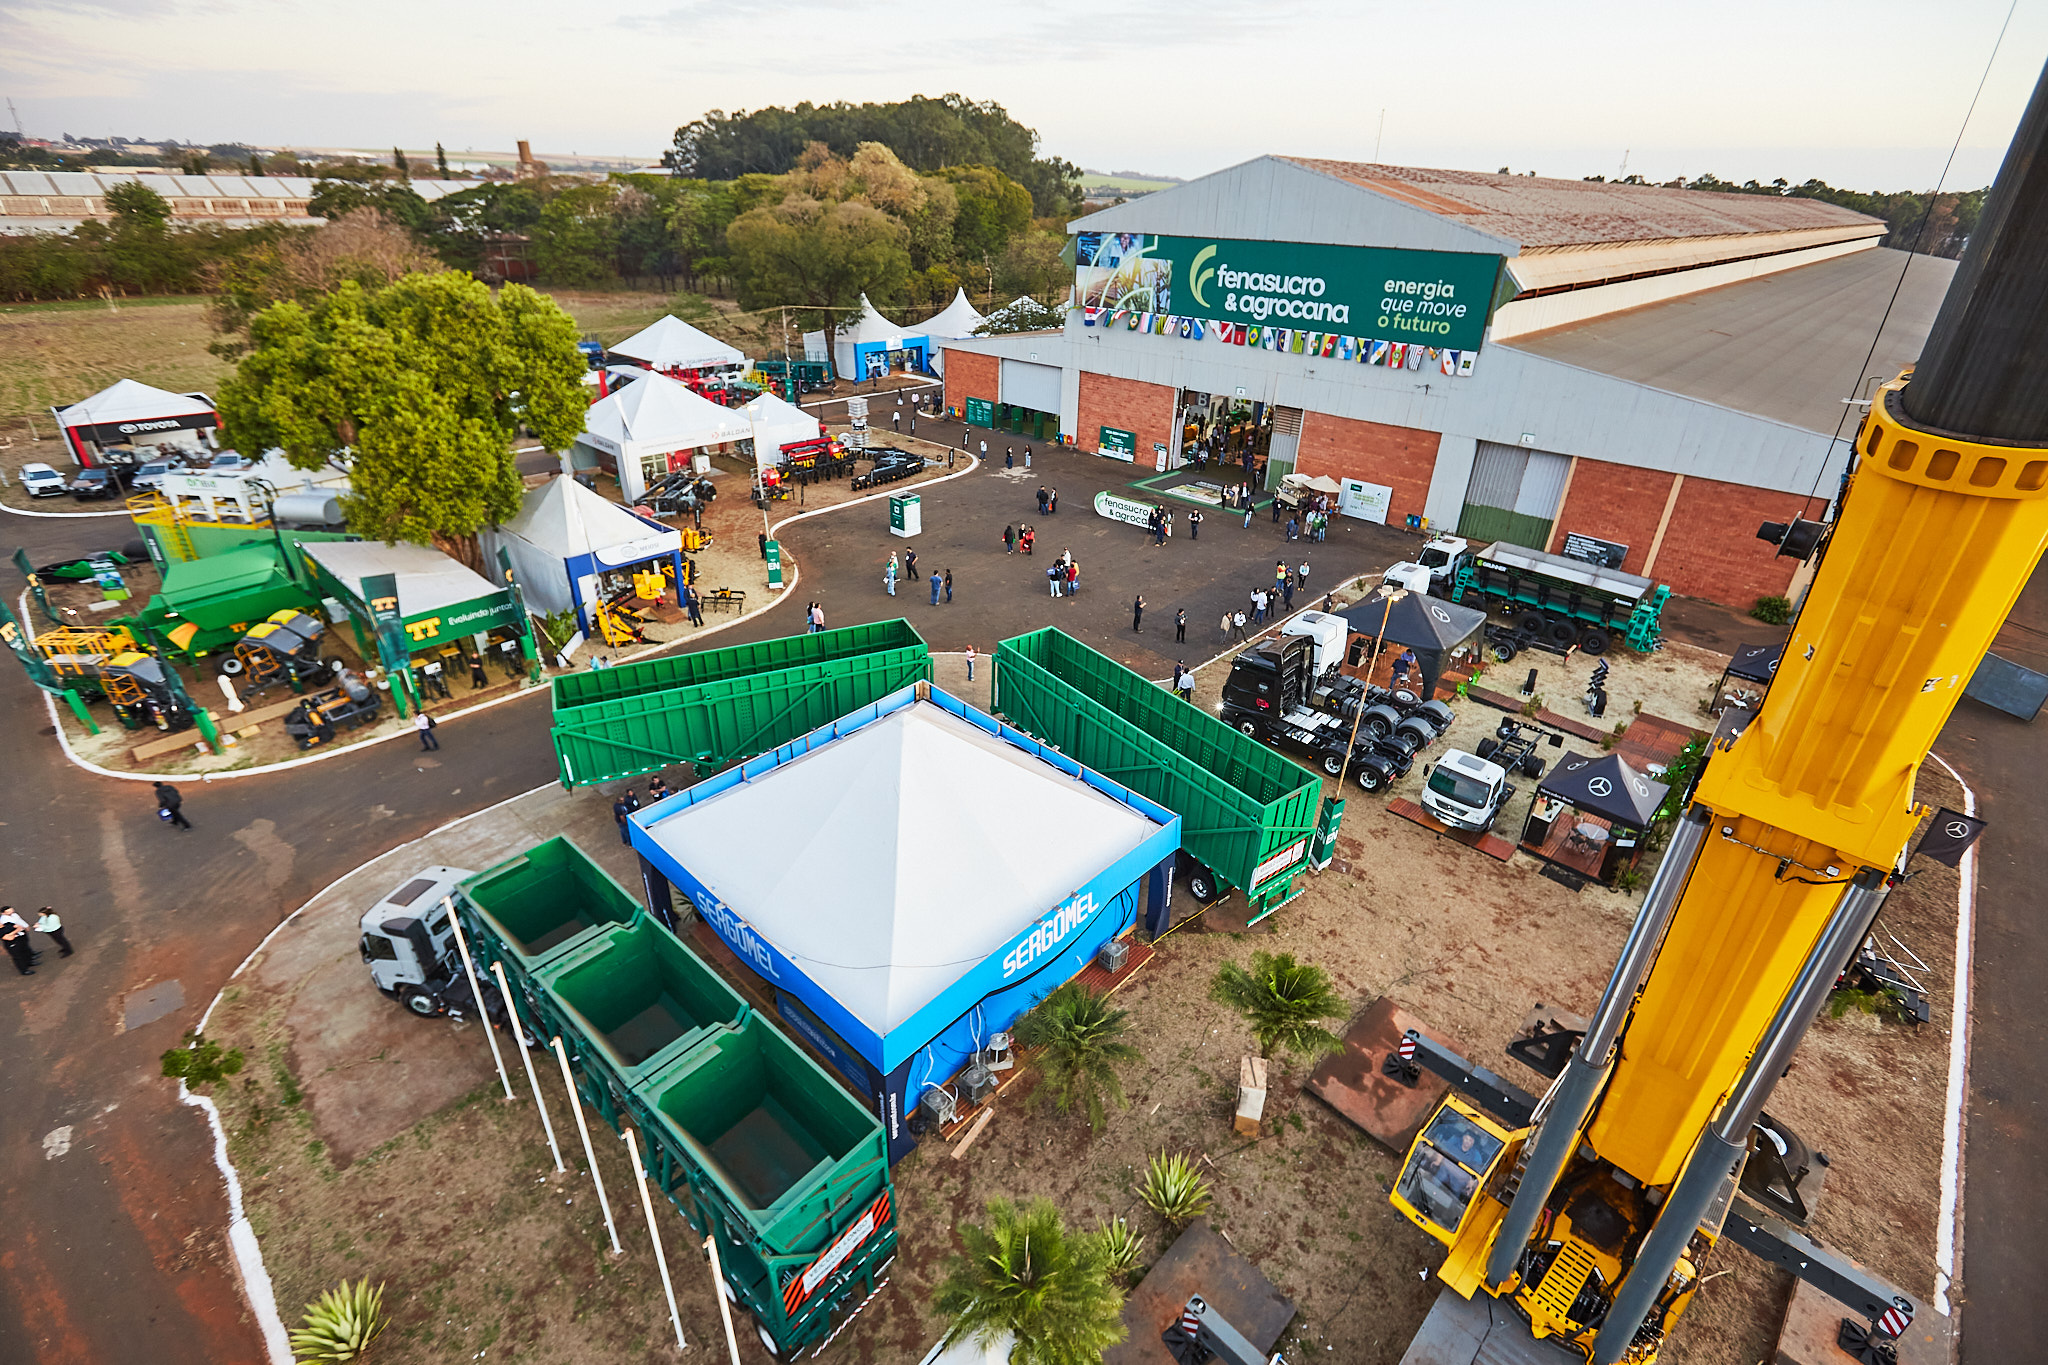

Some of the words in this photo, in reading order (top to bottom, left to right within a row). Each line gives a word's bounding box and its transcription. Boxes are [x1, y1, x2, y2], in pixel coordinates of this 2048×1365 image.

[1217, 264, 1325, 297] fenasucro
[1384, 279, 1454, 299] energia
[1239, 293, 1350, 324] agrocana
[1381, 296, 1413, 314] que
[1416, 299, 1467, 318] move
[1378, 315, 1389, 328] o
[1393, 313, 1450, 335] futuro
[1198, 393, 1208, 406] B
[136, 420, 181, 431] TOYOTA
[721, 427, 751, 437] BALDAN
[1104, 498, 1149, 516] fenasucro
[1115, 510, 1148, 524] agroca
[371, 596, 397, 611] TT
[448, 609, 489, 625] Evoluindo
[489, 603, 513, 616] juntos
[404, 617, 441, 641] TT
[696, 890, 780, 980] SERGOMEL
[1003, 891, 1100, 979] SERGOMEL
